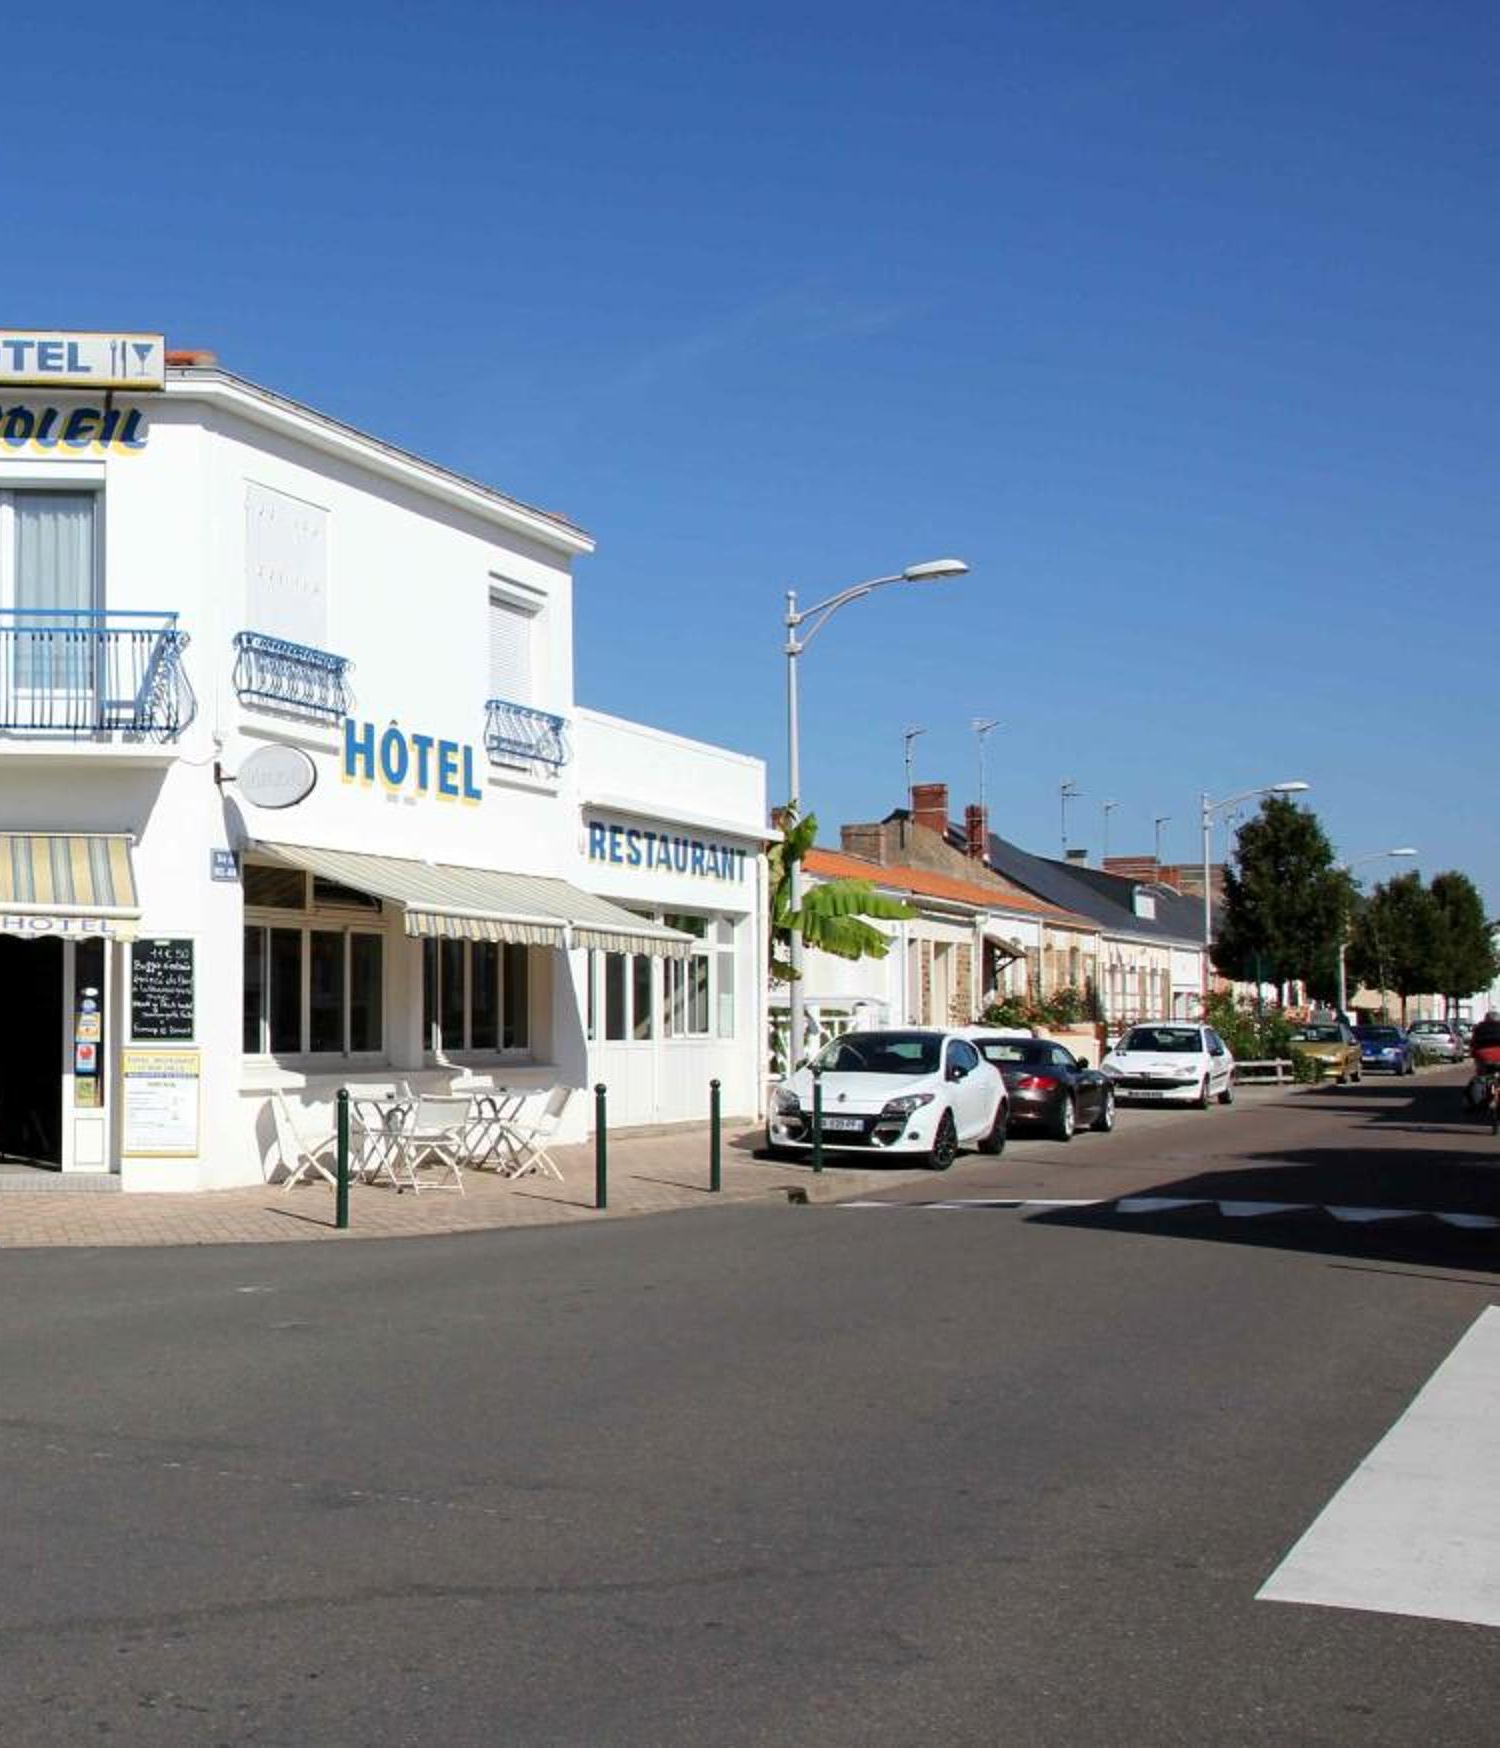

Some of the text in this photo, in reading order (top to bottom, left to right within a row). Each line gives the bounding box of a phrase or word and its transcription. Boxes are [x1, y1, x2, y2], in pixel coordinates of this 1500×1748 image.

[343, 718, 483, 804] HÔTEL
[589, 821, 747, 882] RESTAURANT
[3, 916, 117, 933] HOTEL
